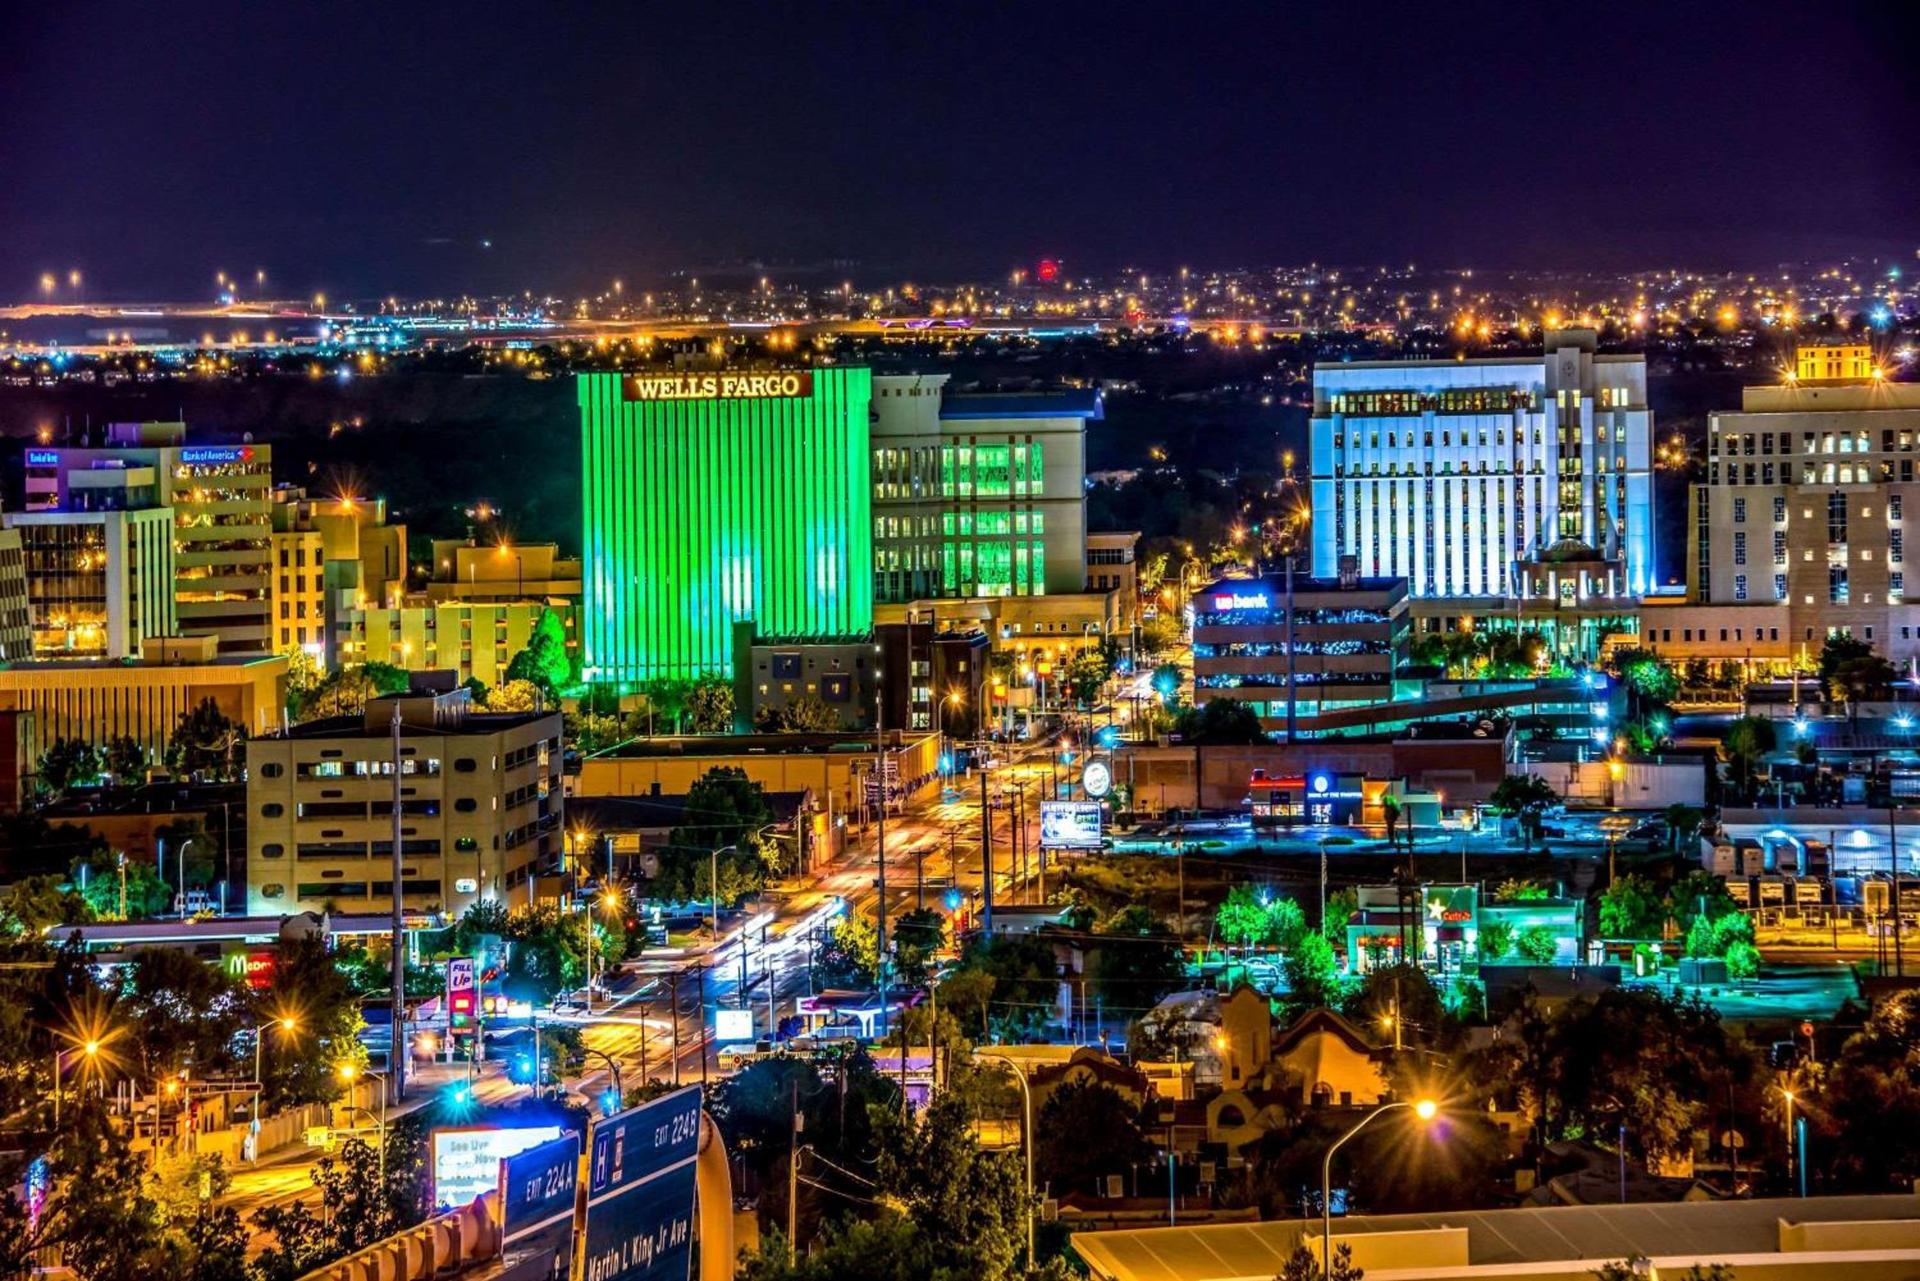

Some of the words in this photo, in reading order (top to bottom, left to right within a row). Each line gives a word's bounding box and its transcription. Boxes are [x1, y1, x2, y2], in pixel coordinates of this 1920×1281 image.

[635, 378, 716, 399] WELLS
[721, 375, 799, 398] FARGO
[183, 450, 200, 461] Bank
[208, 449, 235, 460] America
[452, 964, 472, 972] FILL
[452, 973, 471, 987] UP
[654, 1124, 669, 1148] EXIT
[526, 1176, 542, 1202] EXIT
[544, 1159, 573, 1199] 224A
[588, 1247, 619, 1281] Martin
[621, 1240, 628, 1272] L
[631, 1233, 654, 1270] King
[656, 1223, 668, 1255] Jr
[669, 1218, 687, 1249] Ave
